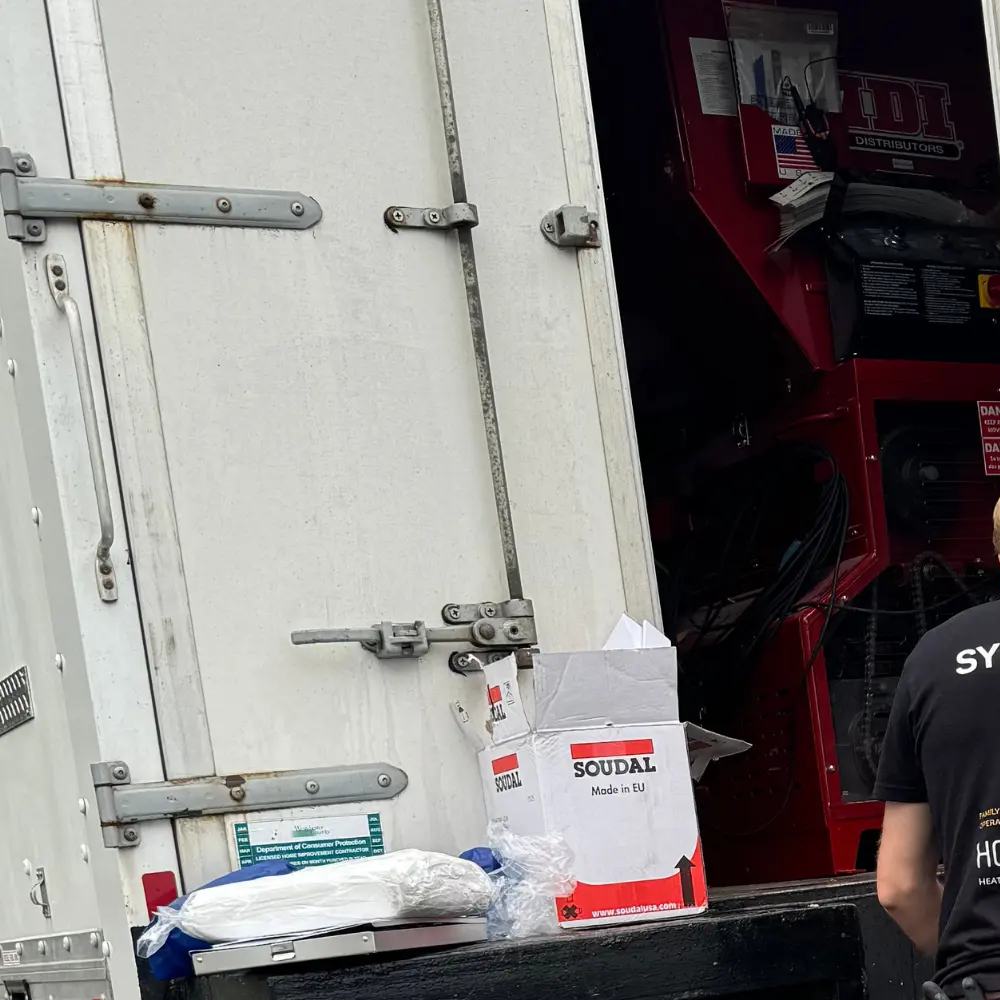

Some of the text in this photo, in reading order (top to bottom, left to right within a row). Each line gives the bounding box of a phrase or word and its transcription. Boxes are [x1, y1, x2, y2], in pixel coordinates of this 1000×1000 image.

[855, 136, 945, 154] DISTRIBUTORS
[573, 757, 656, 778] SOUDAL
[494, 771, 522, 793] SOUDAL
[591, 783, 645, 796] Made in EU
[256, 844, 293, 854] Department
[302, 841, 334, 849] Consumer
[335, 838, 366, 847] Protection
[591, 902, 677, 918] www.soudalusa.com
